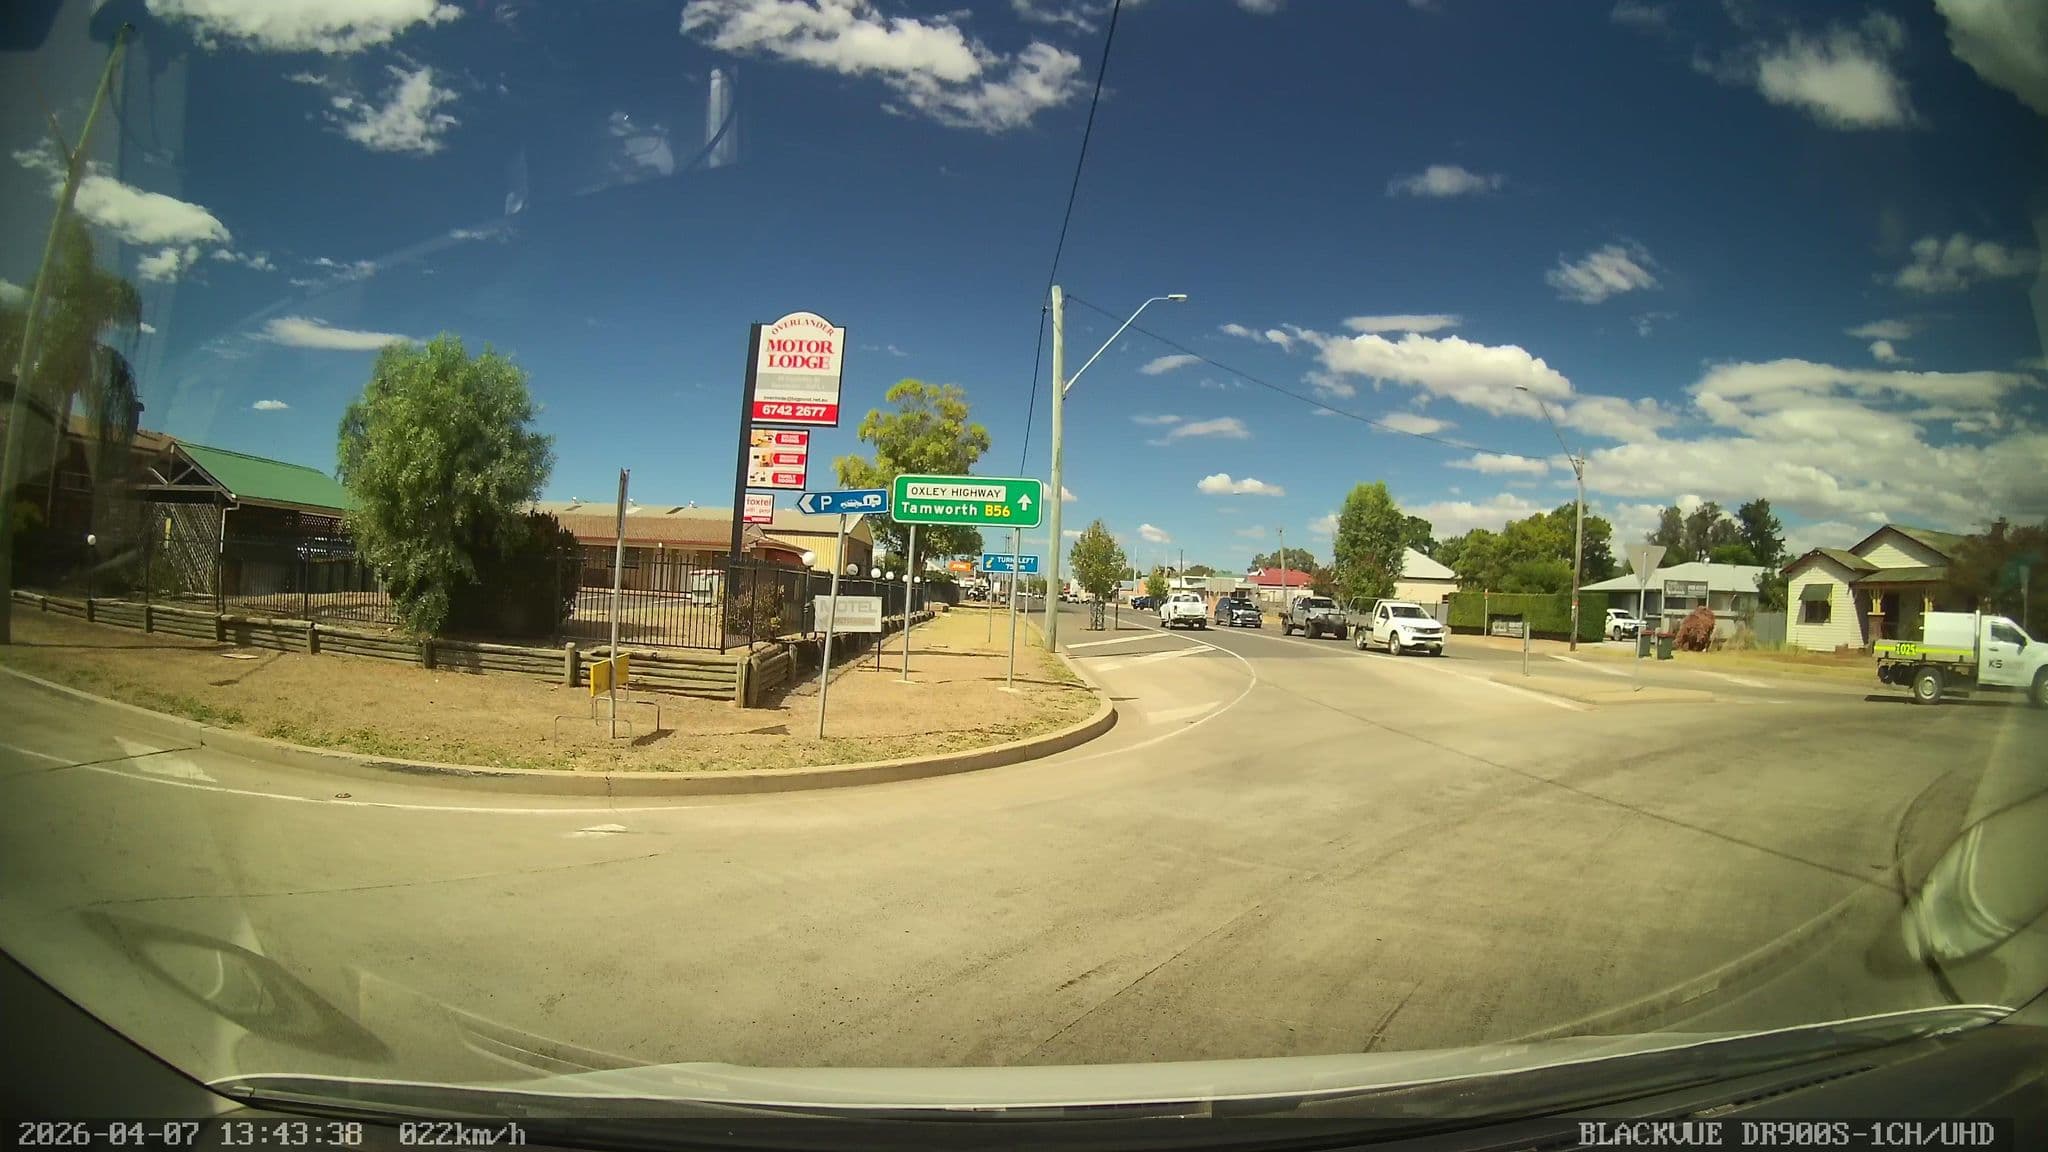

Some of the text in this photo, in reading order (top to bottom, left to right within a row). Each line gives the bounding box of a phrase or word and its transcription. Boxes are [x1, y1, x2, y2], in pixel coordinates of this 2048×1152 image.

[772, 319, 834, 337] OVERLANDER
[767, 339, 834, 354] MOTOR
[767, 354, 830, 369] LODGE
[762, 404, 827, 417] 6742 2677
[911, 486, 1001, 498] OXLEY HIGHWAY
[820, 496, 832, 511] P
[902, 502, 1010, 517] Tamworth B56
[1895, 643, 1916, 656] 1025
